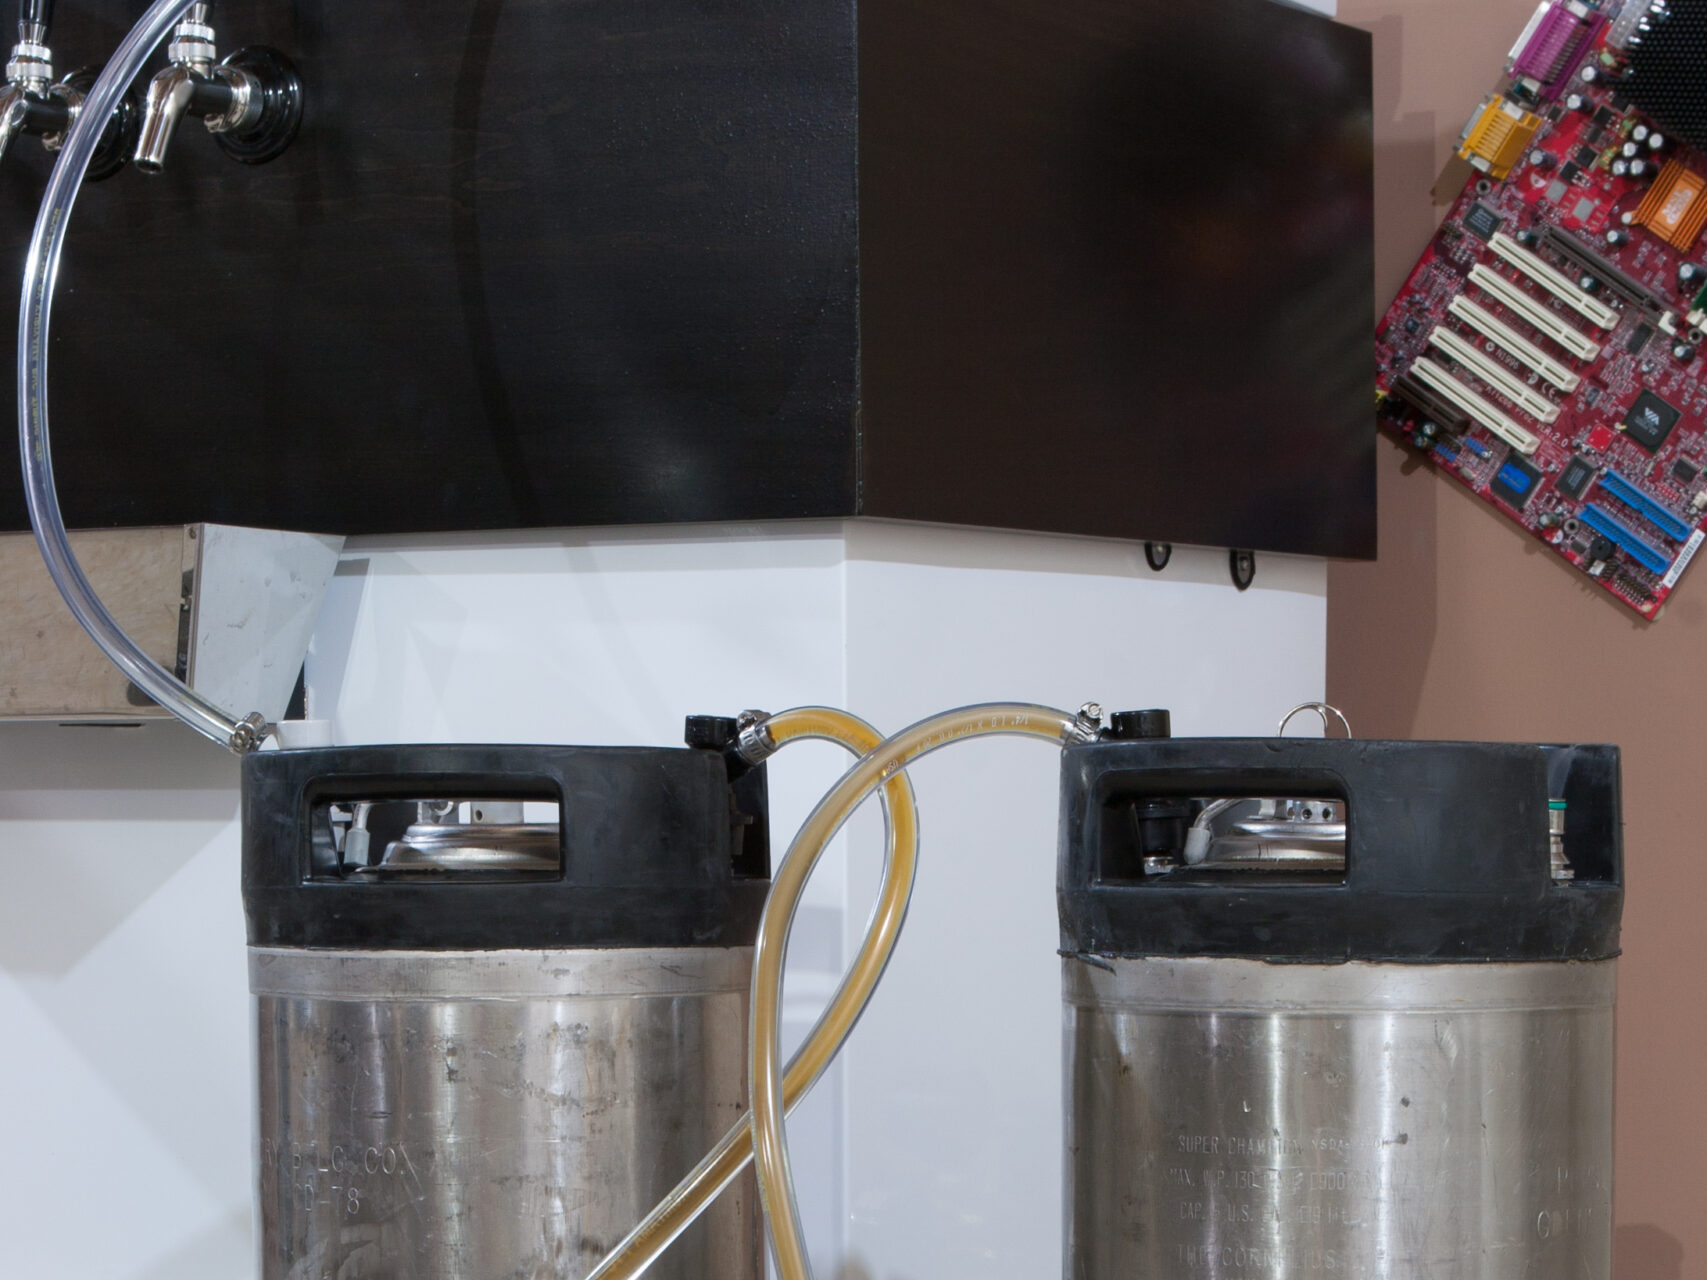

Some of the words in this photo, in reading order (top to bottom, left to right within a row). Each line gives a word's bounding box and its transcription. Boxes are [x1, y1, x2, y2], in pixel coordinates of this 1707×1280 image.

[1643, 407, 1660, 426] VIA
[1177, 1135, 1220, 1155] SUPER
[1180, 1201, 1206, 1220] CAP.
